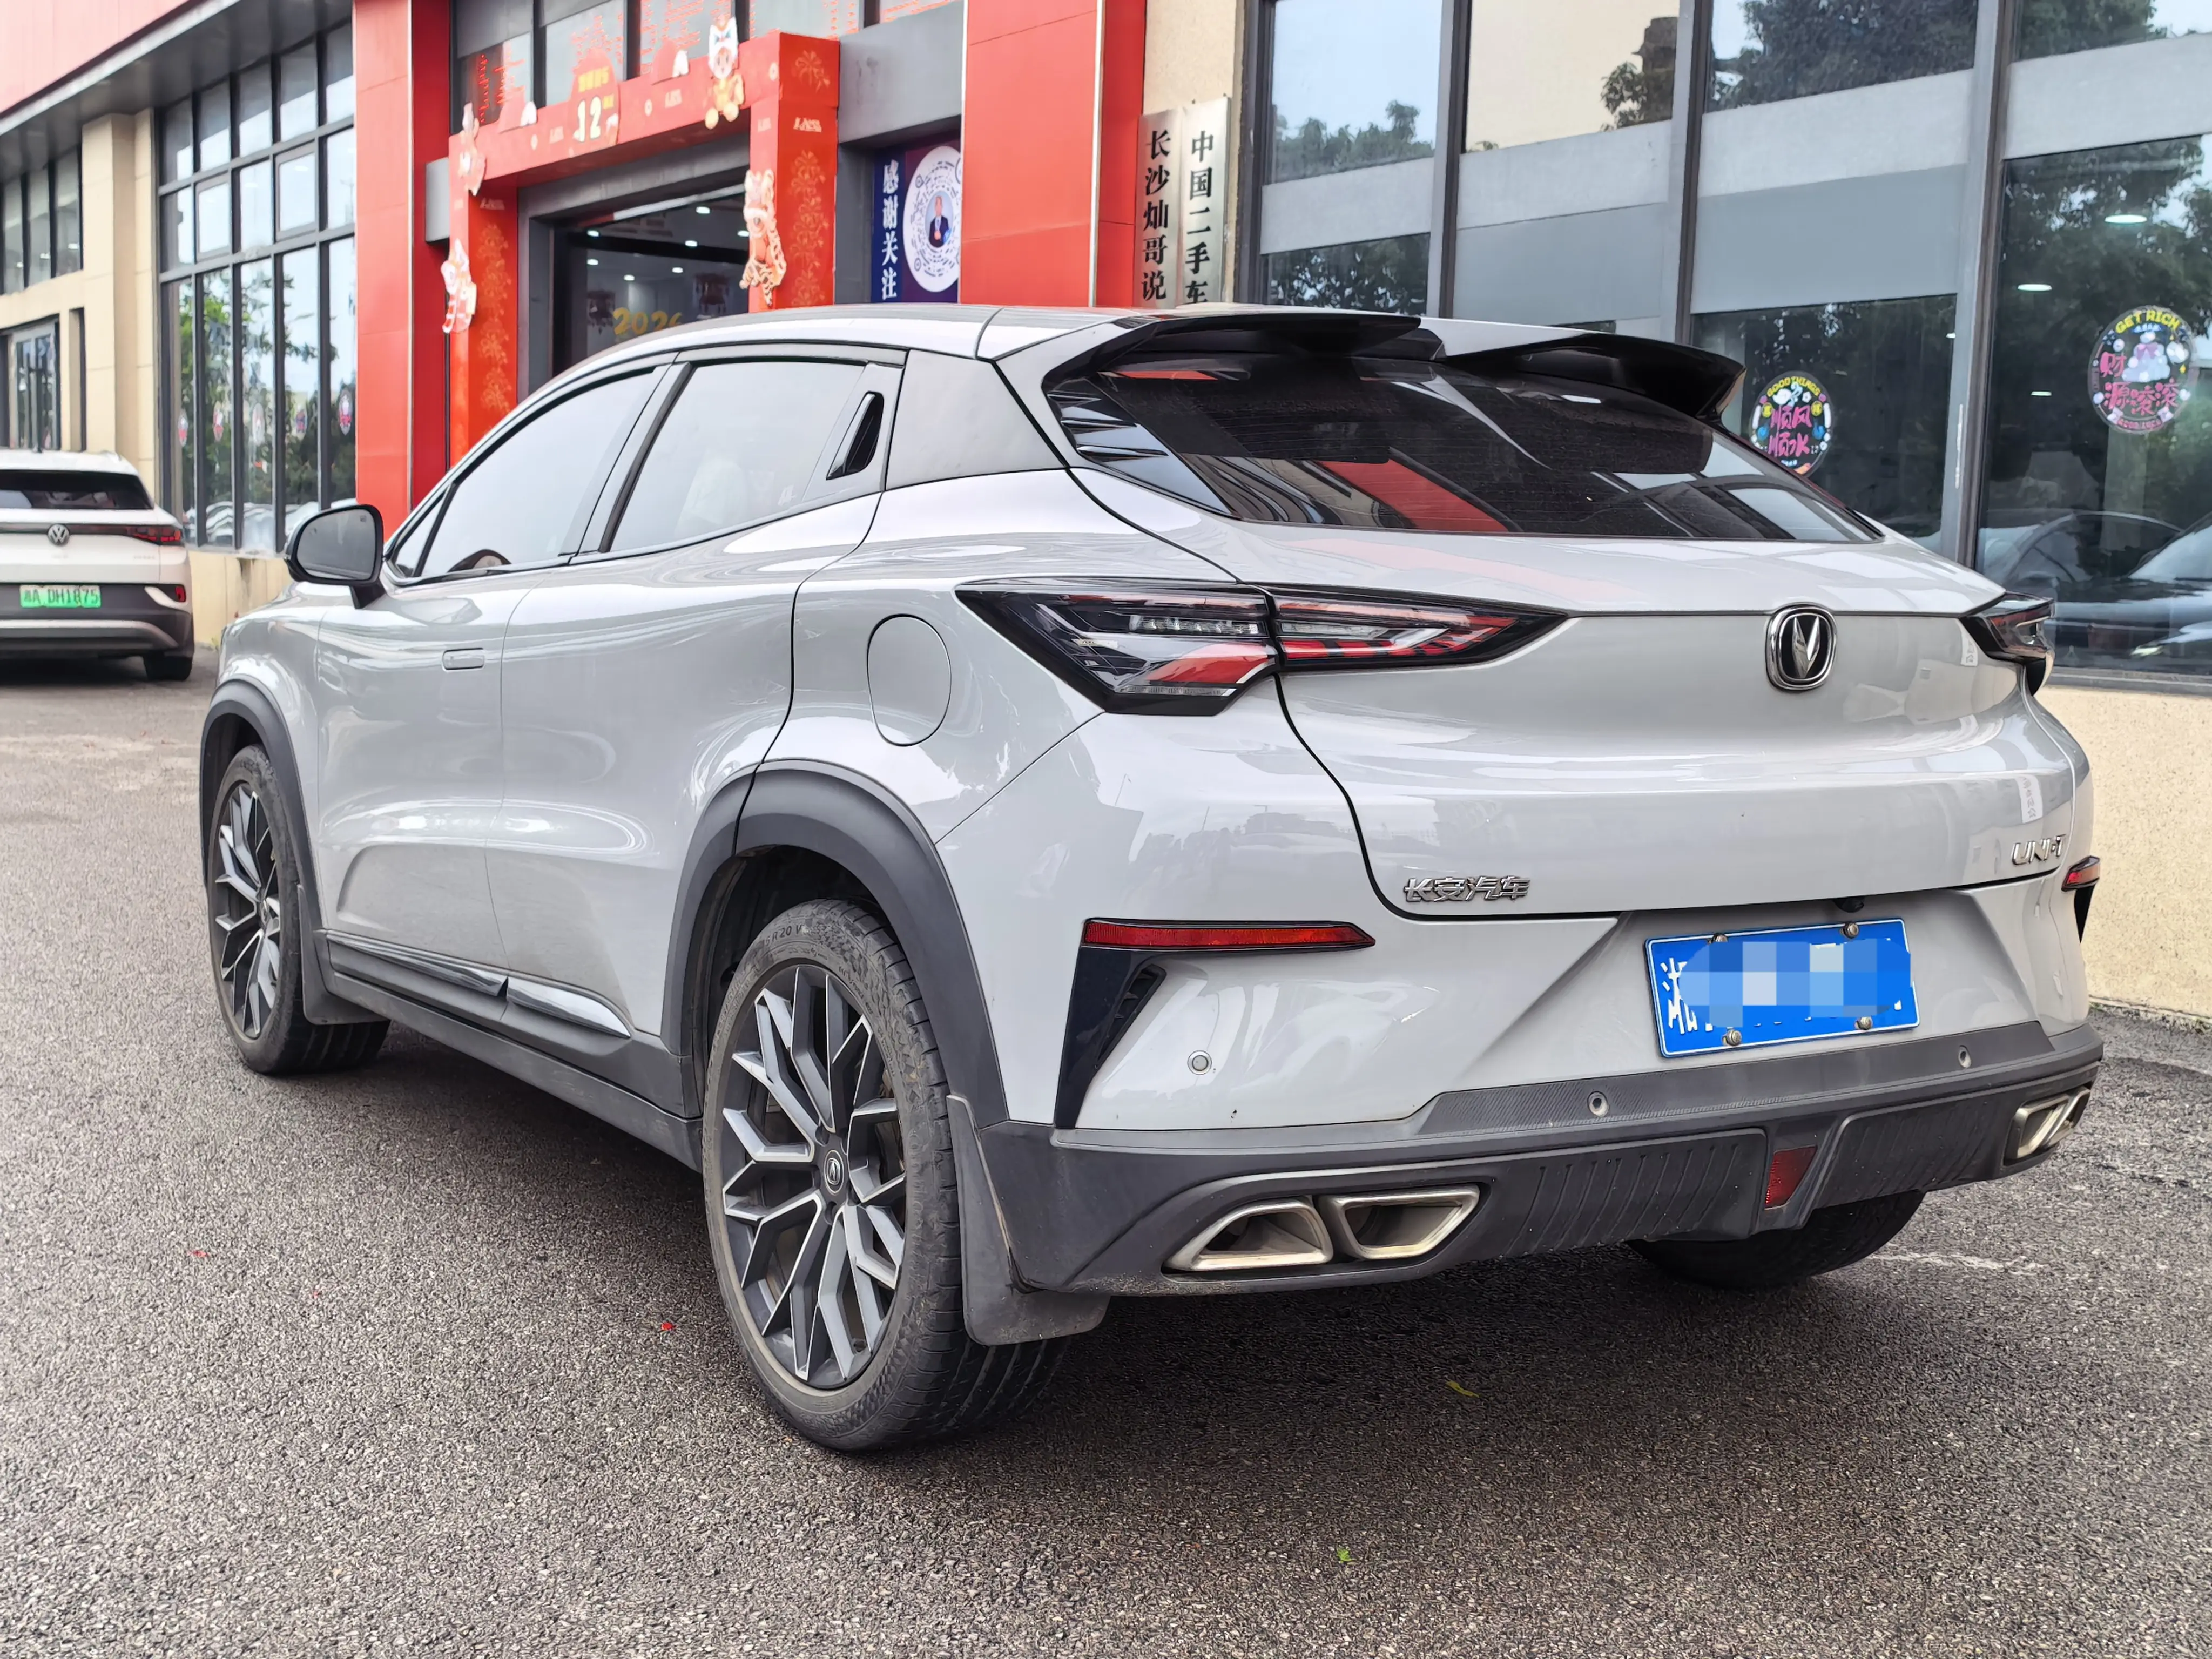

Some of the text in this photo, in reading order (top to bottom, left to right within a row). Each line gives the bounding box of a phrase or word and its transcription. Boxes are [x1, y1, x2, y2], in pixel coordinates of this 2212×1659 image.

[1142, 130, 1171, 301] 长沙灿哥说
[1185, 130, 1214, 305] 中国二手车
[881, 159, 899, 300] 感谢关注
[2115, 313, 2142, 333] GET
[2146, 310, 2181, 331] RICH
[2099, 351, 2127, 377] 财
[1766, 376, 1821, 397] GOOD THINGS
[1770, 405, 1812, 430] 顺风
[1768, 431, 1810, 457] 顺水
[1403, 875, 1532, 902] 长安汽车
